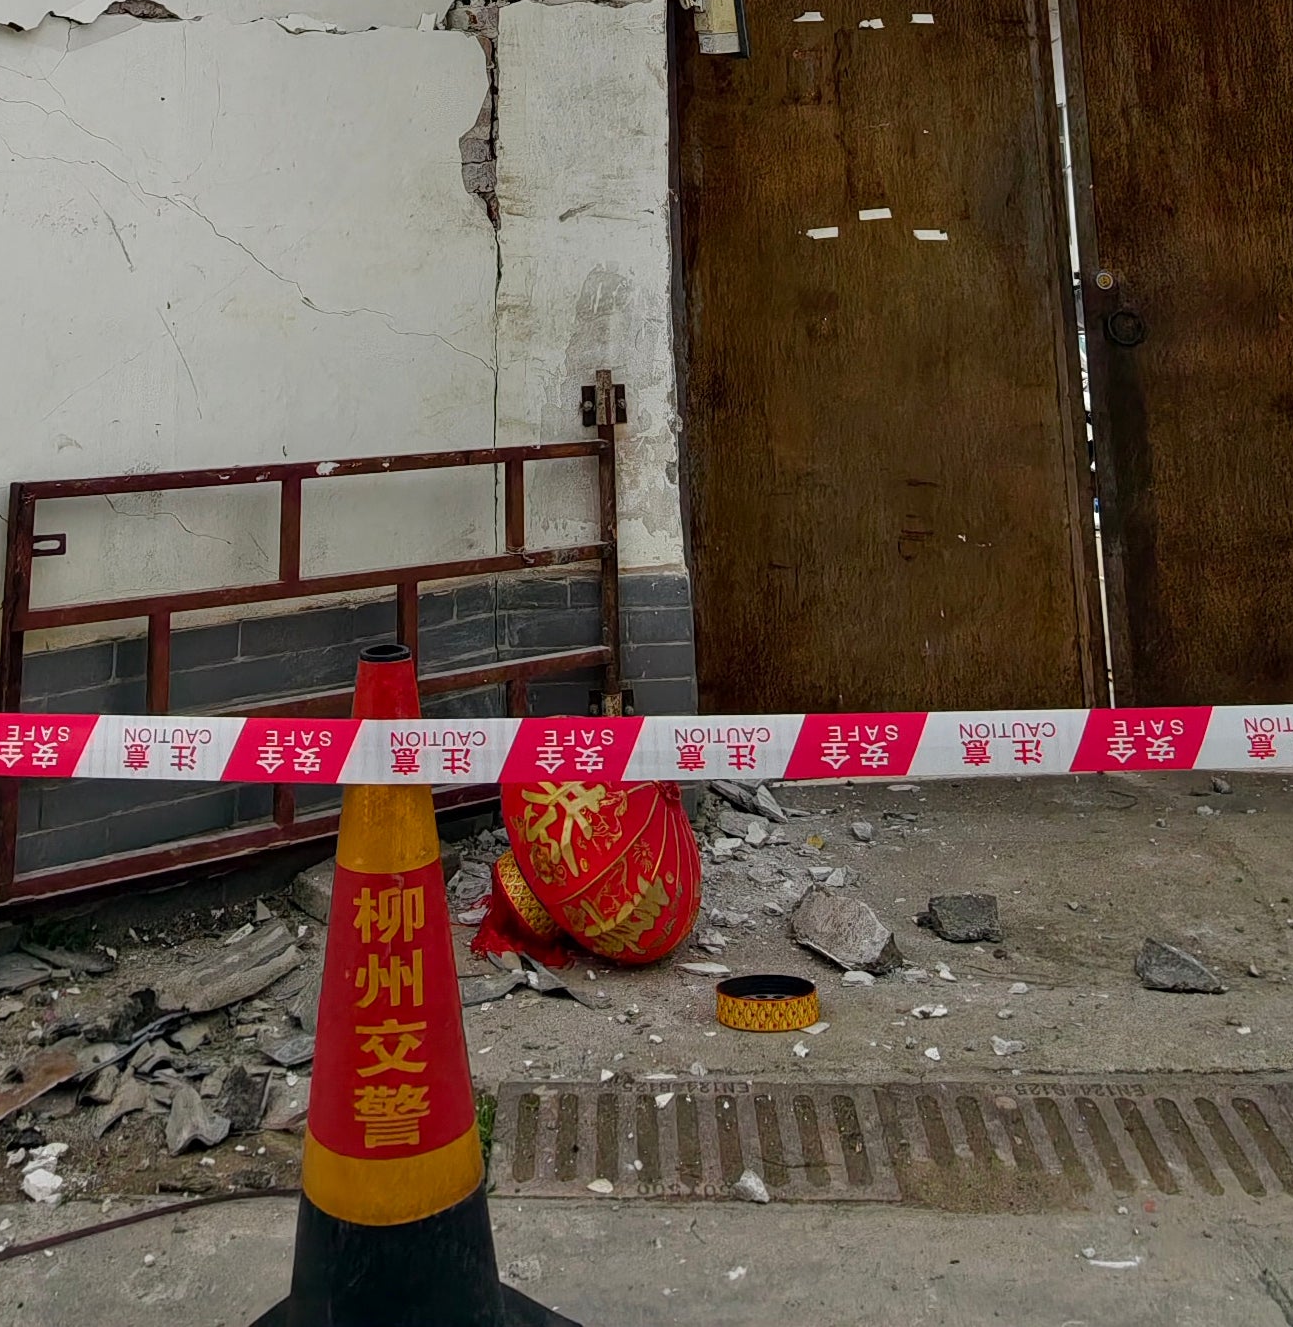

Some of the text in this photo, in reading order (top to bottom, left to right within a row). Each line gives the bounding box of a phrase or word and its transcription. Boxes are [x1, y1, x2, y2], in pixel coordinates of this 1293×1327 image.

[7, 725, 70, 741] SAFE
[125, 728, 212, 744] CAUTION
[266, 729, 332, 746] SAFE
[390, 730, 486, 747] CAUTION
[544, 729, 614, 745] SAFE
[675, 727, 771, 744] CAUTION
[828, 724, 898, 741] SAFE
[960, 721, 1056, 739] CAUTION
[1114, 718, 1184, 736] SAFE
[124, 743, 196, 771] 注意
[256, 745, 322, 774] 安全
[535, 745, 603, 773] 安全
[676, 742, 757, 771] 注意
[821, 740, 890, 769] 安全
[961, 738, 1043, 766] 注意
[1107, 734, 1176, 764] 安全
[390, 747, 471, 775] 注意
[353, 885, 430, 1149] 柳州交警
